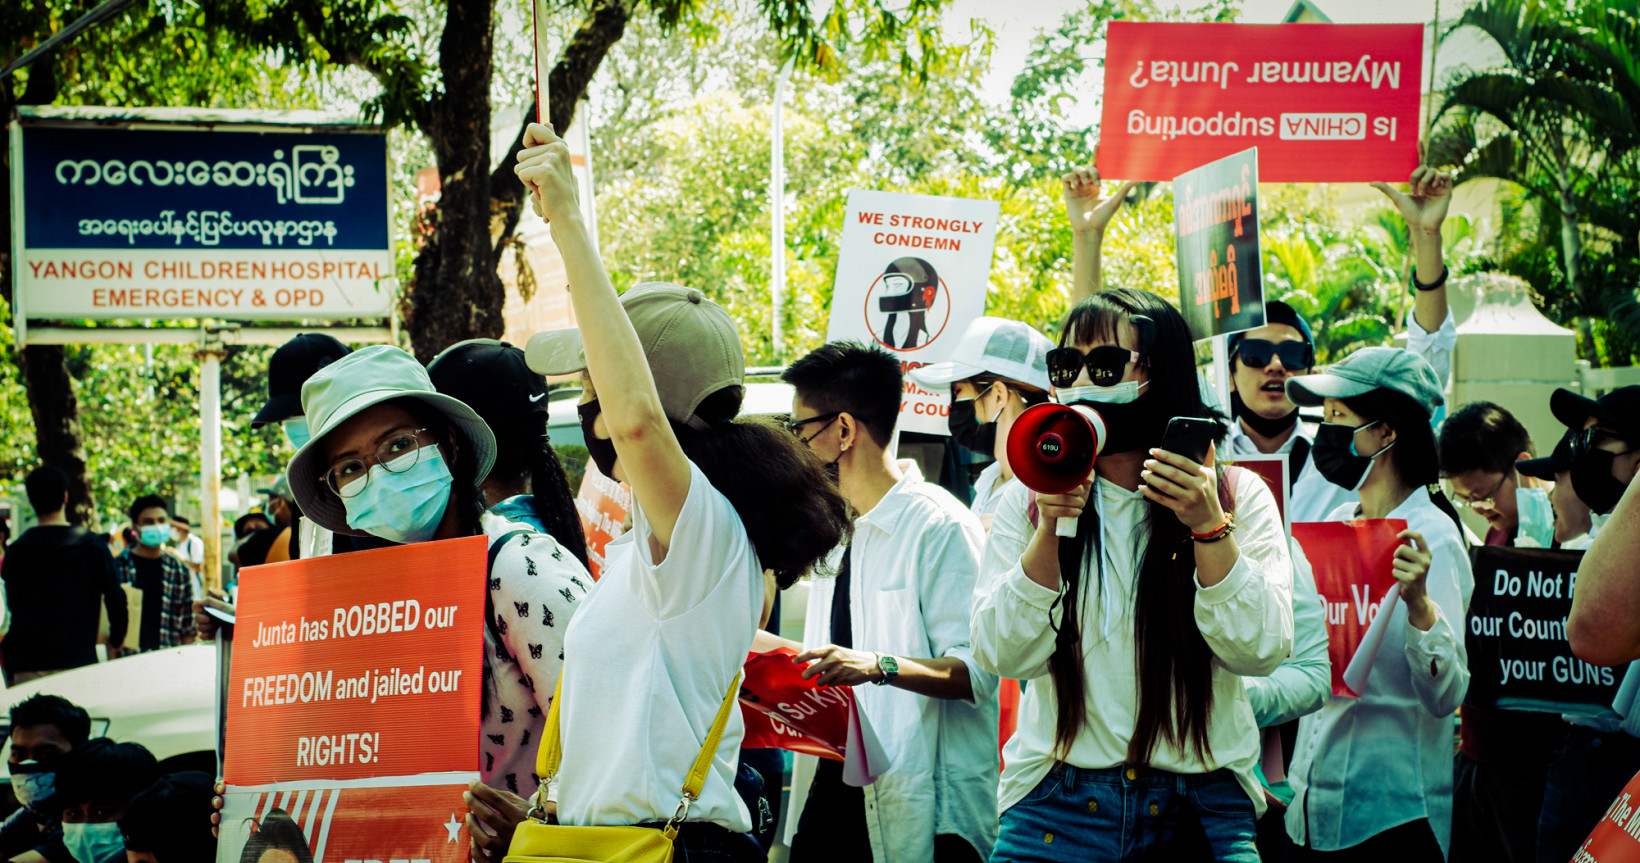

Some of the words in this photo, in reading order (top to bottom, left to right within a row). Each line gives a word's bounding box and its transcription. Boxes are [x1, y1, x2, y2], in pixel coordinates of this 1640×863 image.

[1129, 60, 1239, 89] Junta?
[1246, 54, 1400, 89] Myanmar
[1127, 109, 1275, 140] supporting
[1286, 116, 1361, 135] CHINA
[1373, 116, 1397, 141] Is
[858, 211, 884, 225] WE
[889, 214, 983, 234] STRONGLY
[873, 232, 961, 251] CONDEMN
[29, 261, 132, 279] YANGON
[144, 261, 266, 280] CHILDREN
[271, 261, 383, 280] HOSPITAL
[93, 288, 243, 308] EMERGENCY
[251, 289, 267, 308] &
[275, 288, 324, 307] OPD
[913, 402, 950, 418] COU
[1493, 569, 1522, 597] Do
[1526, 570, 1563, 599] Not
[252, 621, 296, 648] Junta
[299, 616, 329, 642] has
[332, 599, 420, 639] ROBBED
[424, 605, 458, 629] our
[1471, 615, 1503, 637] our
[1500, 658, 1546, 685] your
[242, 669, 333, 708] FREEDOM
[335, 670, 370, 700] and
[371, 665, 424, 704] jailed
[428, 669, 462, 694] our
[777, 702, 817, 720] Su
[803, 685, 850, 708] Ky
[296, 732, 380, 767] RIGHTS!
